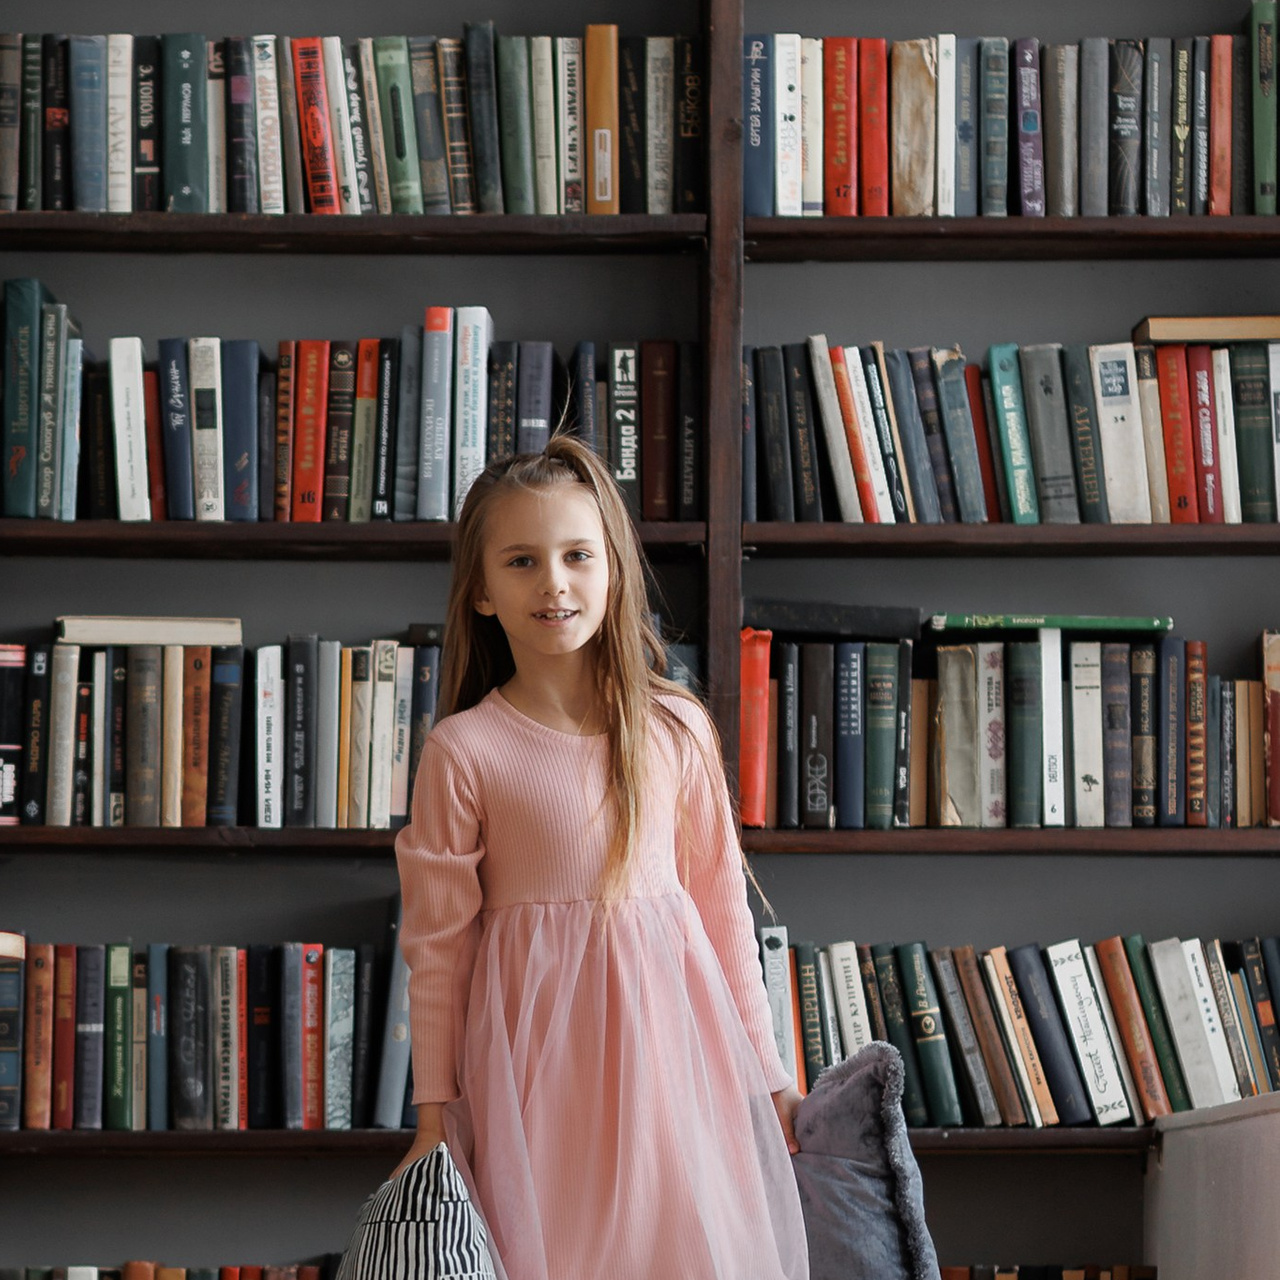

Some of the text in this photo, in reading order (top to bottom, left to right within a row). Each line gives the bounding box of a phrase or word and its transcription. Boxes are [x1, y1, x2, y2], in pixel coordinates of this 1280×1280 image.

[139, 64, 154, 128] Э. ТОПОЛЬ
[258, 75, 273, 111] МИР
[749, 68, 762, 147] СЕРГЕЙ ЗАЛЫГИН
[261, 114, 276, 186] ПОЗНАЮ
[47, 313, 56, 337] СНЫ
[472, 324, 481, 368] лучшему
[470, 379, 479, 411] бизнес
[1197, 370, 1210, 406] БОРИС
[41, 411, 54, 462] Сологуб
[423, 398, 434, 479] ПСИХОЛОГИЯ
[433, 416, 444, 461] ОБЩАЯ
[461, 417, 470, 448] Роман
[471, 414, 479, 448] меняет
[615, 408, 635, 480] Банда 2
[40, 467, 53, 507] Федор
[841, 662, 849, 736] АЛЕКСАНДР
[29, 699, 41, 773] ЭНДРЮ ГАРВ
[2, 763, 17, 803] ВОЙНА
[807, 753, 827, 812] БОРХЕС
[1048, 754, 1058, 784] DEUTSCH
[844, 964, 860, 1017] КУПРИН
[220, 998, 231, 1124] ВЕРНЕЙСКИЕ ГРАЧИ
[1088, 1050, 1107, 1094] Ernest
